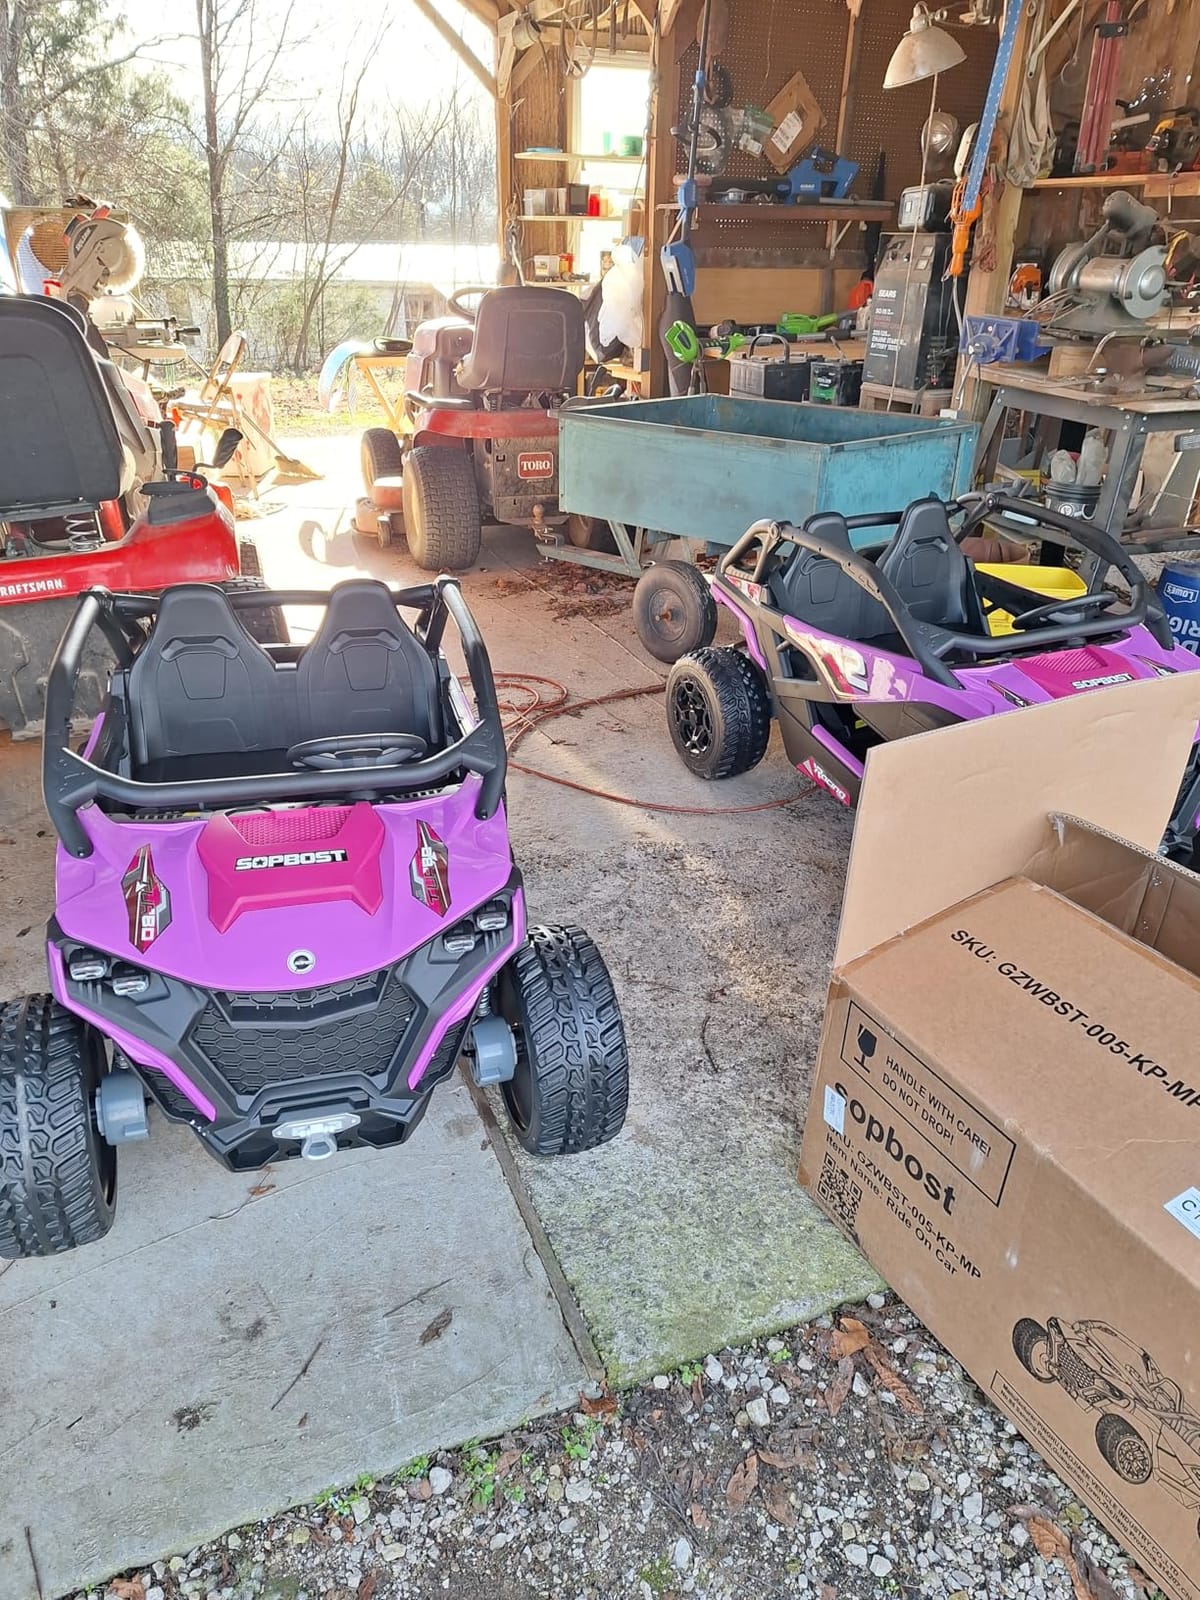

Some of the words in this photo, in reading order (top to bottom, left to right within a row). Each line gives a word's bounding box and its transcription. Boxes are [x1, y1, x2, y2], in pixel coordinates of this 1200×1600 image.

[878, 289, 897, 298] SEARS
[521, 460, 550, 470] TORO
[0, 578, 62, 597] RAFTSMAN
[1072, 673, 1133, 689] SOPBOST
[235, 849, 346, 871] SOPBOST
[951, 929, 996, 963] SKU:
[882, 1073, 897, 1092] DO
[899, 1088, 920, 1112] NOT
[921, 1109, 954, 1146] DROP!
[886, 1055, 927, 1099] HANDLE
[928, 1092, 955, 1125] WITH
[956, 1120, 992, 1158] CARE!
[826, 1132, 847, 1161] Item
[850, 1158, 883, 1199] Name:
[886, 1196, 912, 1228] Ride
[915, 1227, 932, 1250] On
[935, 1248, 958, 1275] Car
[857, 1150, 981, 1278] GZWBST-005-KP-MP
[1117, 1507, 1151, 1546] INDUSTRY
